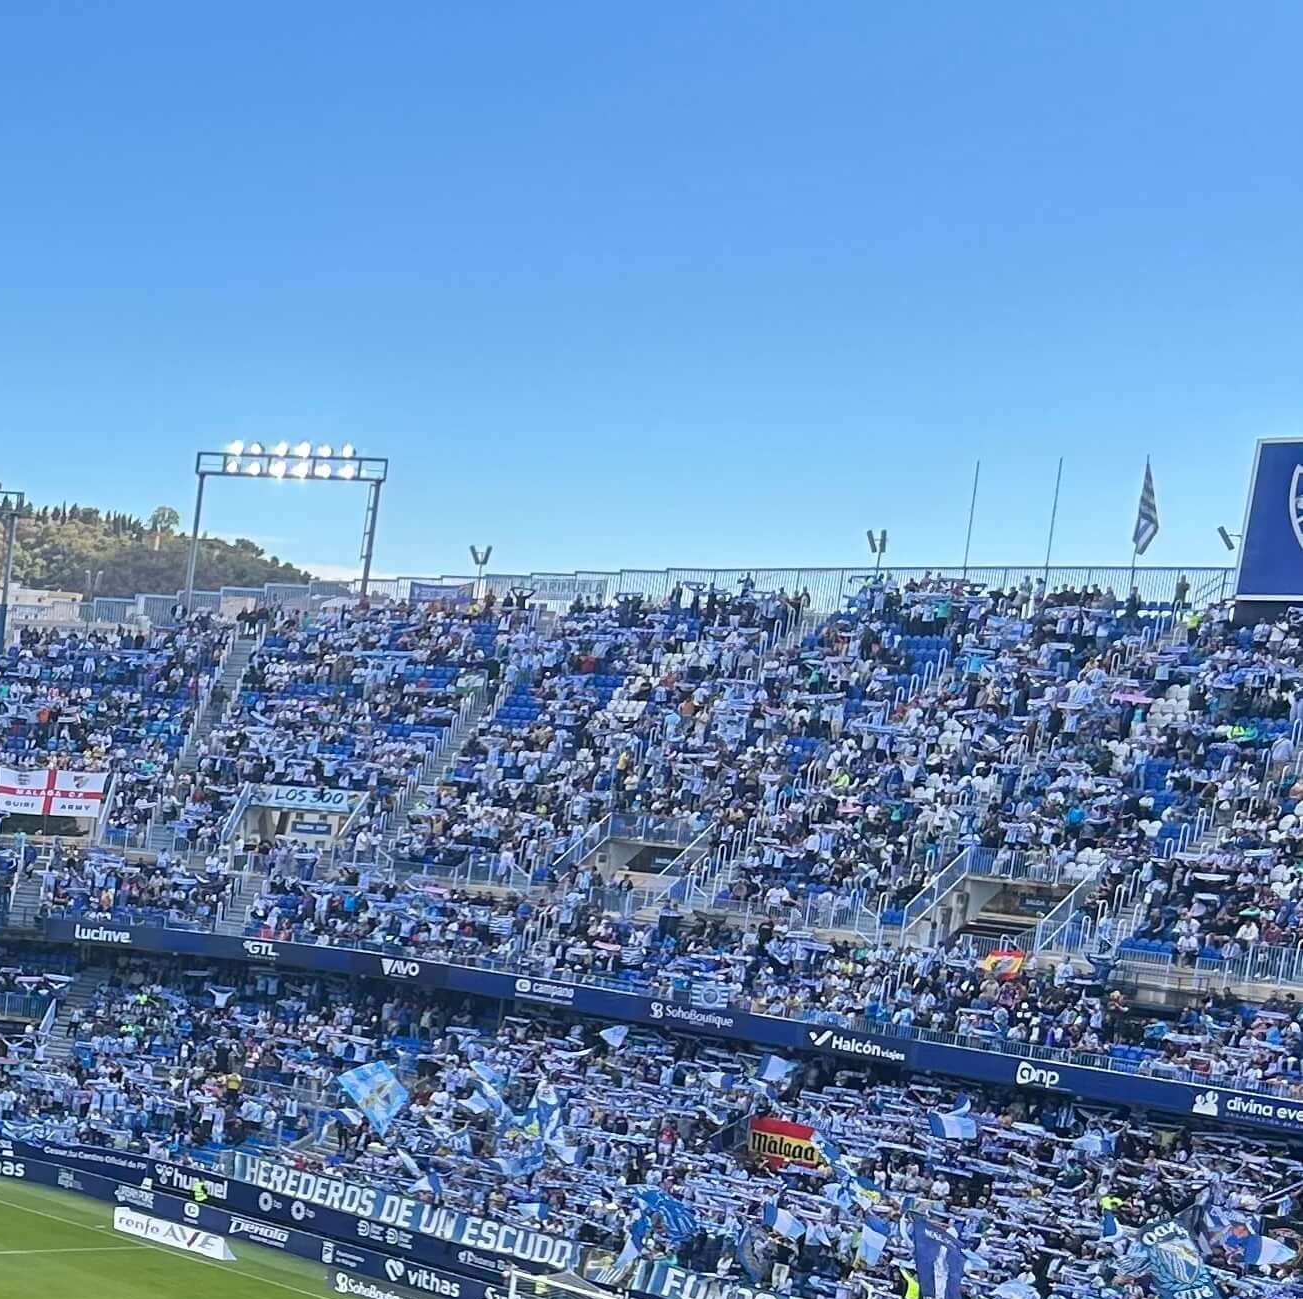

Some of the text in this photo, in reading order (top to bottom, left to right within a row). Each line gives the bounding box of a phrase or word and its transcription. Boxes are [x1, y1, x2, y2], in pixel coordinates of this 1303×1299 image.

[275, 788, 307, 801] LOS
[665, 1004, 733, 1028] SohoBoutique
[832, 1035, 881, 1057] Halcón
[1226, 1096, 1273, 1117] divina
[244, 1152, 573, 1270] HEREDEROS DE UN ESCUDO
[118, 1215, 160, 1235] renfe
[163, 1222, 216, 1251] AVE
[407, 1269, 460, 1298] vithas
